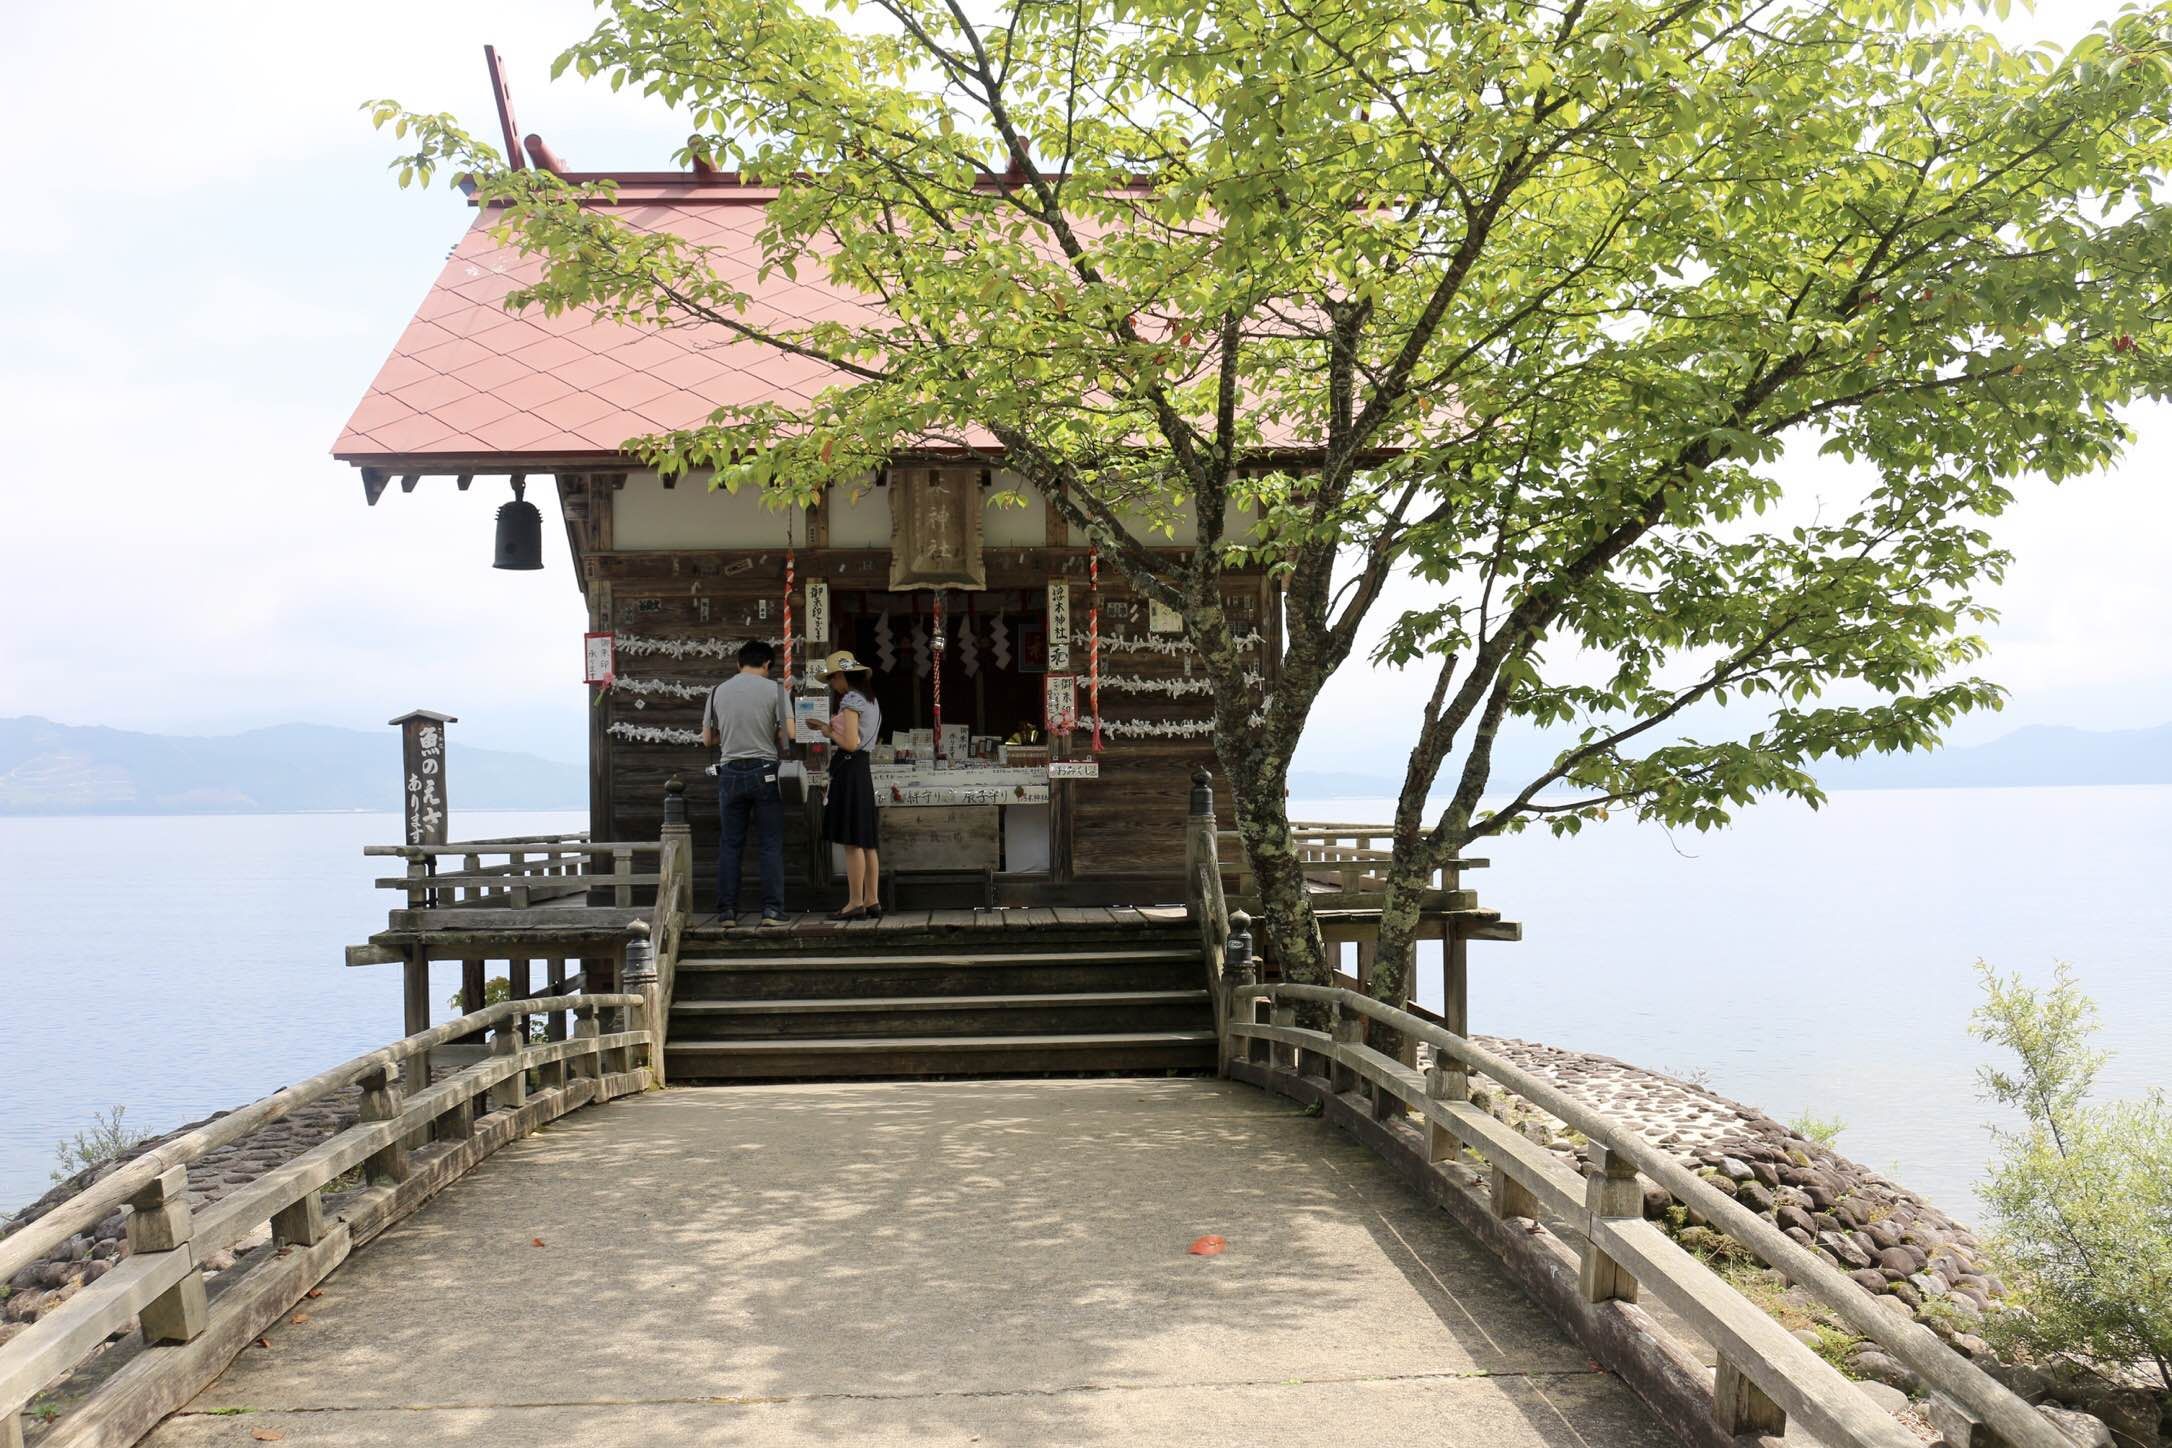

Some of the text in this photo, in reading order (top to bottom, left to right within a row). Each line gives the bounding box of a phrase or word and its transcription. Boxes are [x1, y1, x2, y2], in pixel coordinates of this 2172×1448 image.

[407, 773, 423, 844] あります
[419, 726, 442, 833] 魚のえさ
